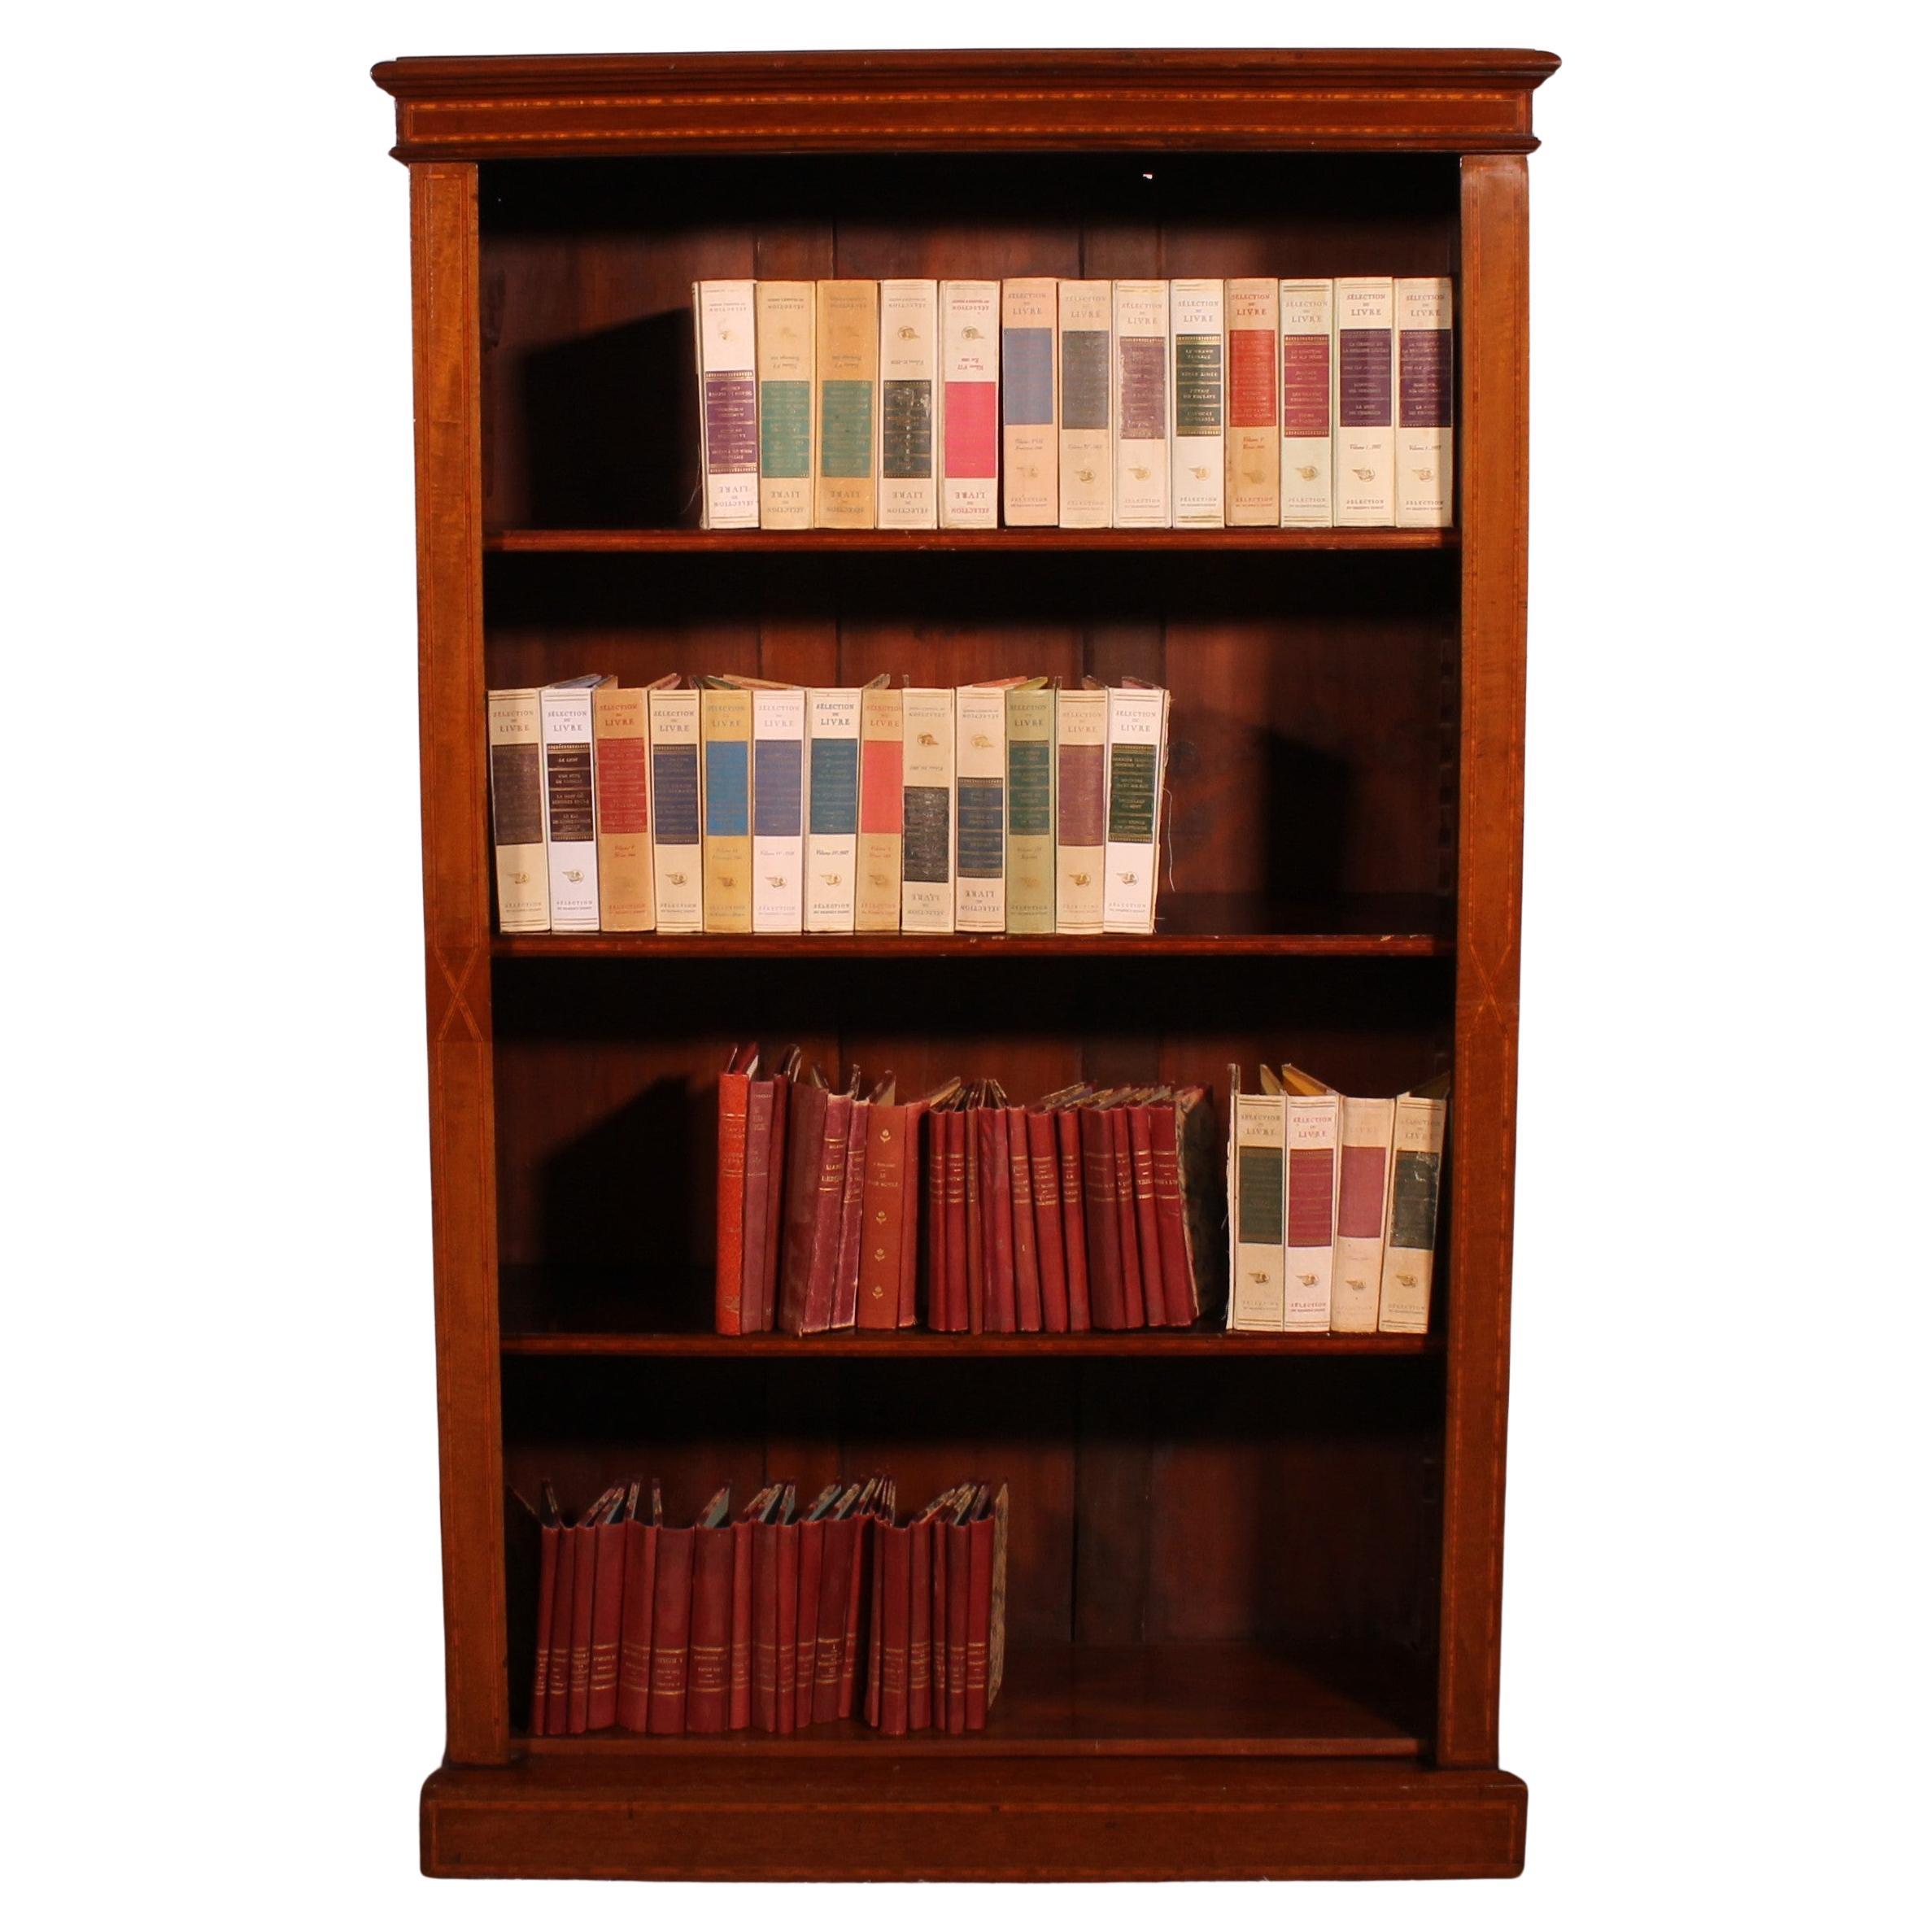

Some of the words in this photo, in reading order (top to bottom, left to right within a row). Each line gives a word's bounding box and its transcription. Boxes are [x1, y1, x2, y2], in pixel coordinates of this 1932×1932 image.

[1008, 292, 1047, 300] SÉLECTION
[1231, 293, 1270, 301] SÉLECTION
[1346, 293, 1386, 301] SÉLECTION
[1406, 294, 1446, 302] SÉLECTION
[1122, 302, 1163, 310] SÉLECTION
[1178, 299, 1219, 307] SÉLECTION
[1012, 307, 1043, 316] LIVRE
[1071, 310, 1101, 319] LIVRE
[1236, 307, 1267, 316] LIVRE
[1350, 308, 1382, 316] LIVRE
[1411, 309, 1441, 317] LIVRE
[1127, 317, 1158, 325] LIVRE
[1183, 315, 1215, 323] LIVRE
[1291, 315, 1323, 324] LIVRE
[717, 485, 748, 494] LIVRE
[770, 491, 800, 499] LIVRE
[830, 491, 860, 499] LIVRE
[891, 491, 923, 499] LIVRE
[954, 491, 986, 499] LIVRE
[765, 506, 805, 514] SÉLECTION
[886, 506, 928, 515] SÉLECTION
[950, 506, 990, 515] SÉLECTION
[600, 704, 639, 712] SÉLECTION
[815, 702, 855, 711] SÉLECTION
[1009, 703, 1048, 712] SÉLECTION
[494, 709, 535, 717] SÉLECTION
[1115, 709, 1157, 718] SÉLECTION
[604, 717, 636, 727] LIVRE
[712, 719, 741, 727] LIVRE
[764, 719, 795, 728] LIVRE
[820, 718, 851, 726] LIVRE
[870, 720, 901, 728] LIVRE
[1014, 718, 1044, 727] LIVRE
[499, 723, 531, 733] LIVRE
[553, 723, 584, 732] LIVRE
[659, 724, 691, 733] LIVRE
[1067, 725, 1097, 733] LIVRE
[1120, 723, 1151, 733] LIVRE
[912, 893, 940, 901] LIVRE
[965, 889, 995, 898] LIVRE
[960, 904, 1001, 912] SÉLECTION
[1293, 1116, 1332, 1124] SÉLECTION
[1246, 1127, 1276, 1136] LIVRE
